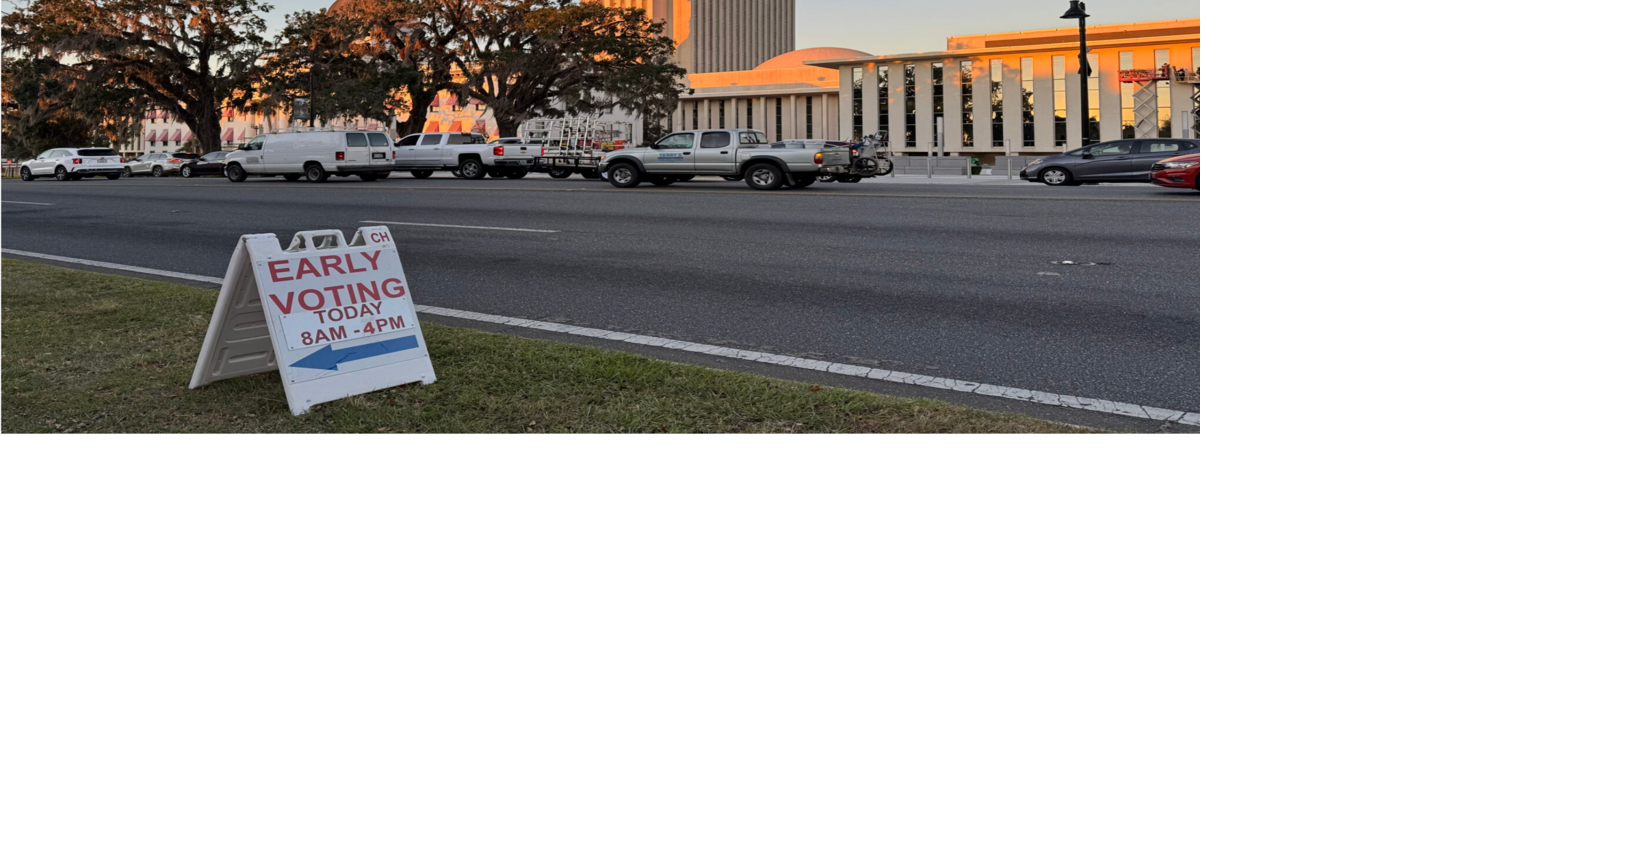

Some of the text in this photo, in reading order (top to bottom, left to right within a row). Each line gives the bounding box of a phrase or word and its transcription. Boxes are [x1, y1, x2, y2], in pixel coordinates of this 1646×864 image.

[370, 232, 390, 243] CH
[267, 250, 381, 282] EARLY
[269, 278, 405, 315] VOTING
[313, 301, 382, 324] TODAY
[301, 325, 347, 346] 8AM
